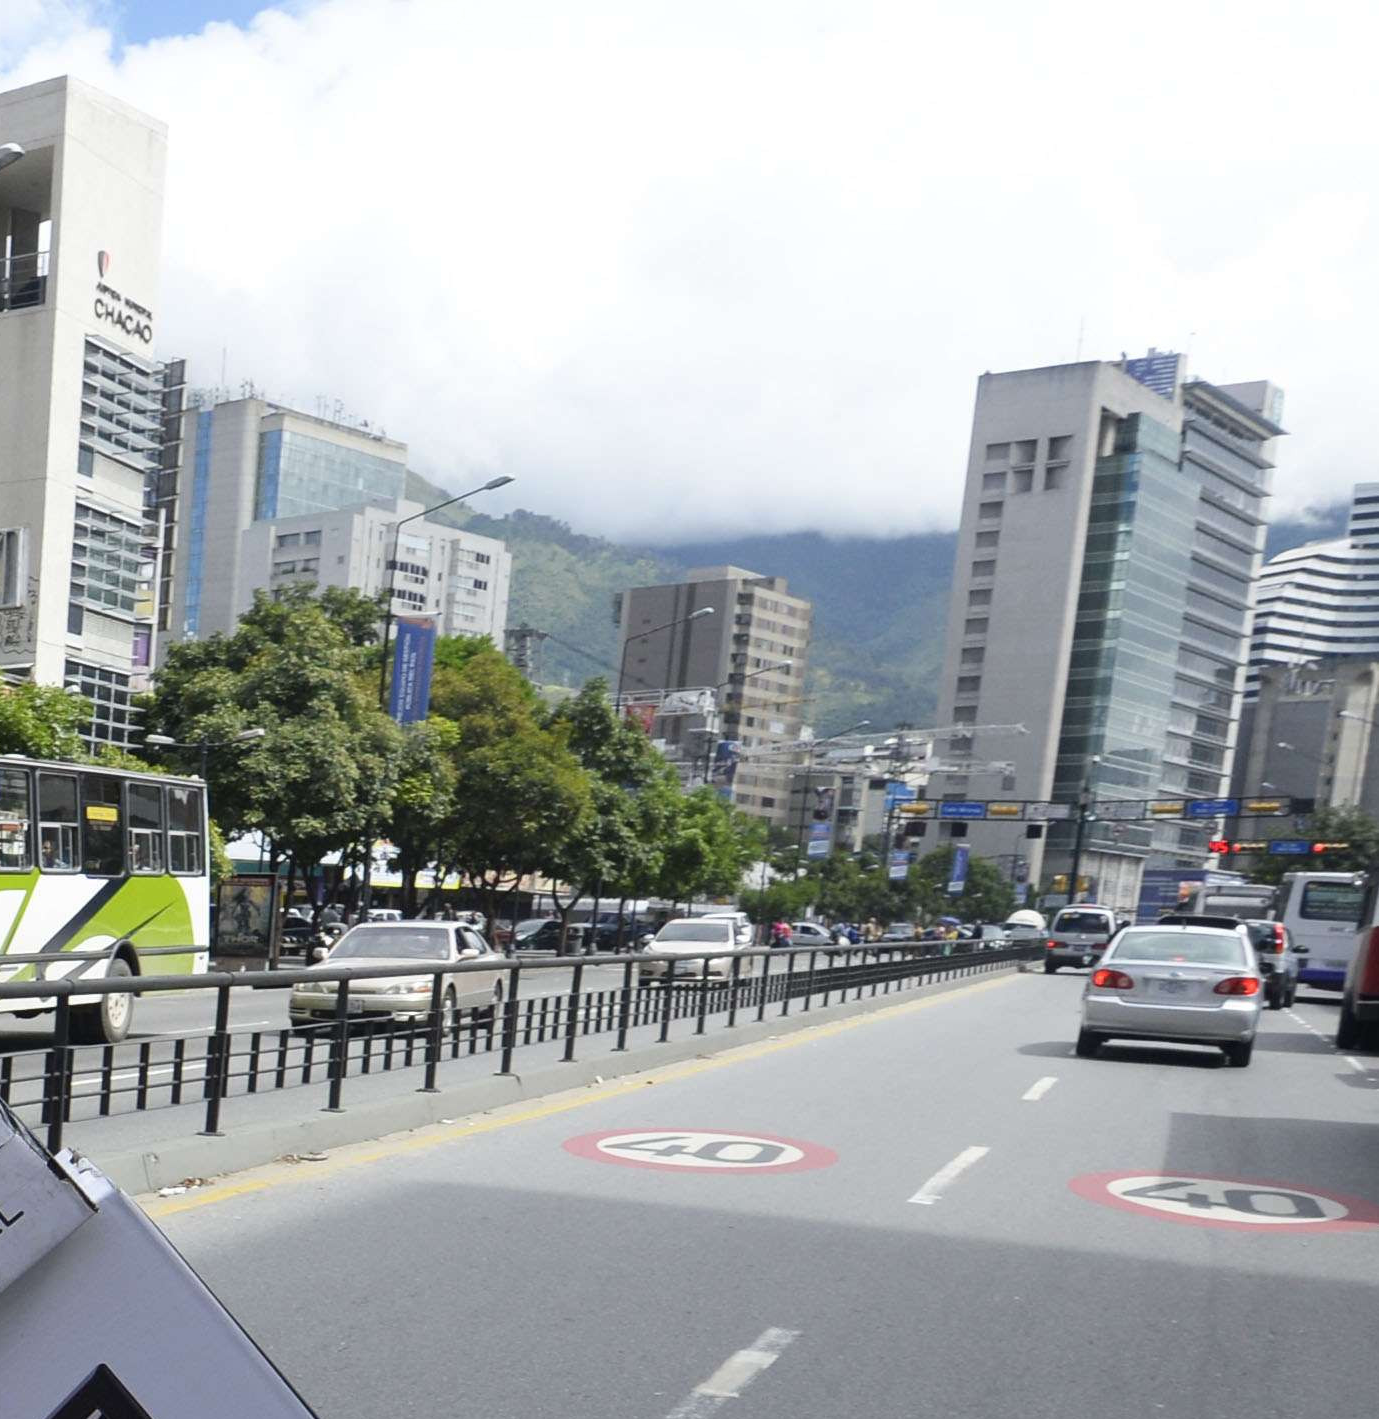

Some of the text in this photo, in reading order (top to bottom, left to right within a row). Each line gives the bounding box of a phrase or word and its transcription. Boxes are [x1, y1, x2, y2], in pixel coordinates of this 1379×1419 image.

[95, 298, 152, 343] CHACAO
[605, 1136, 785, 1164] 40
[1121, 1181, 1328, 1219] 40
